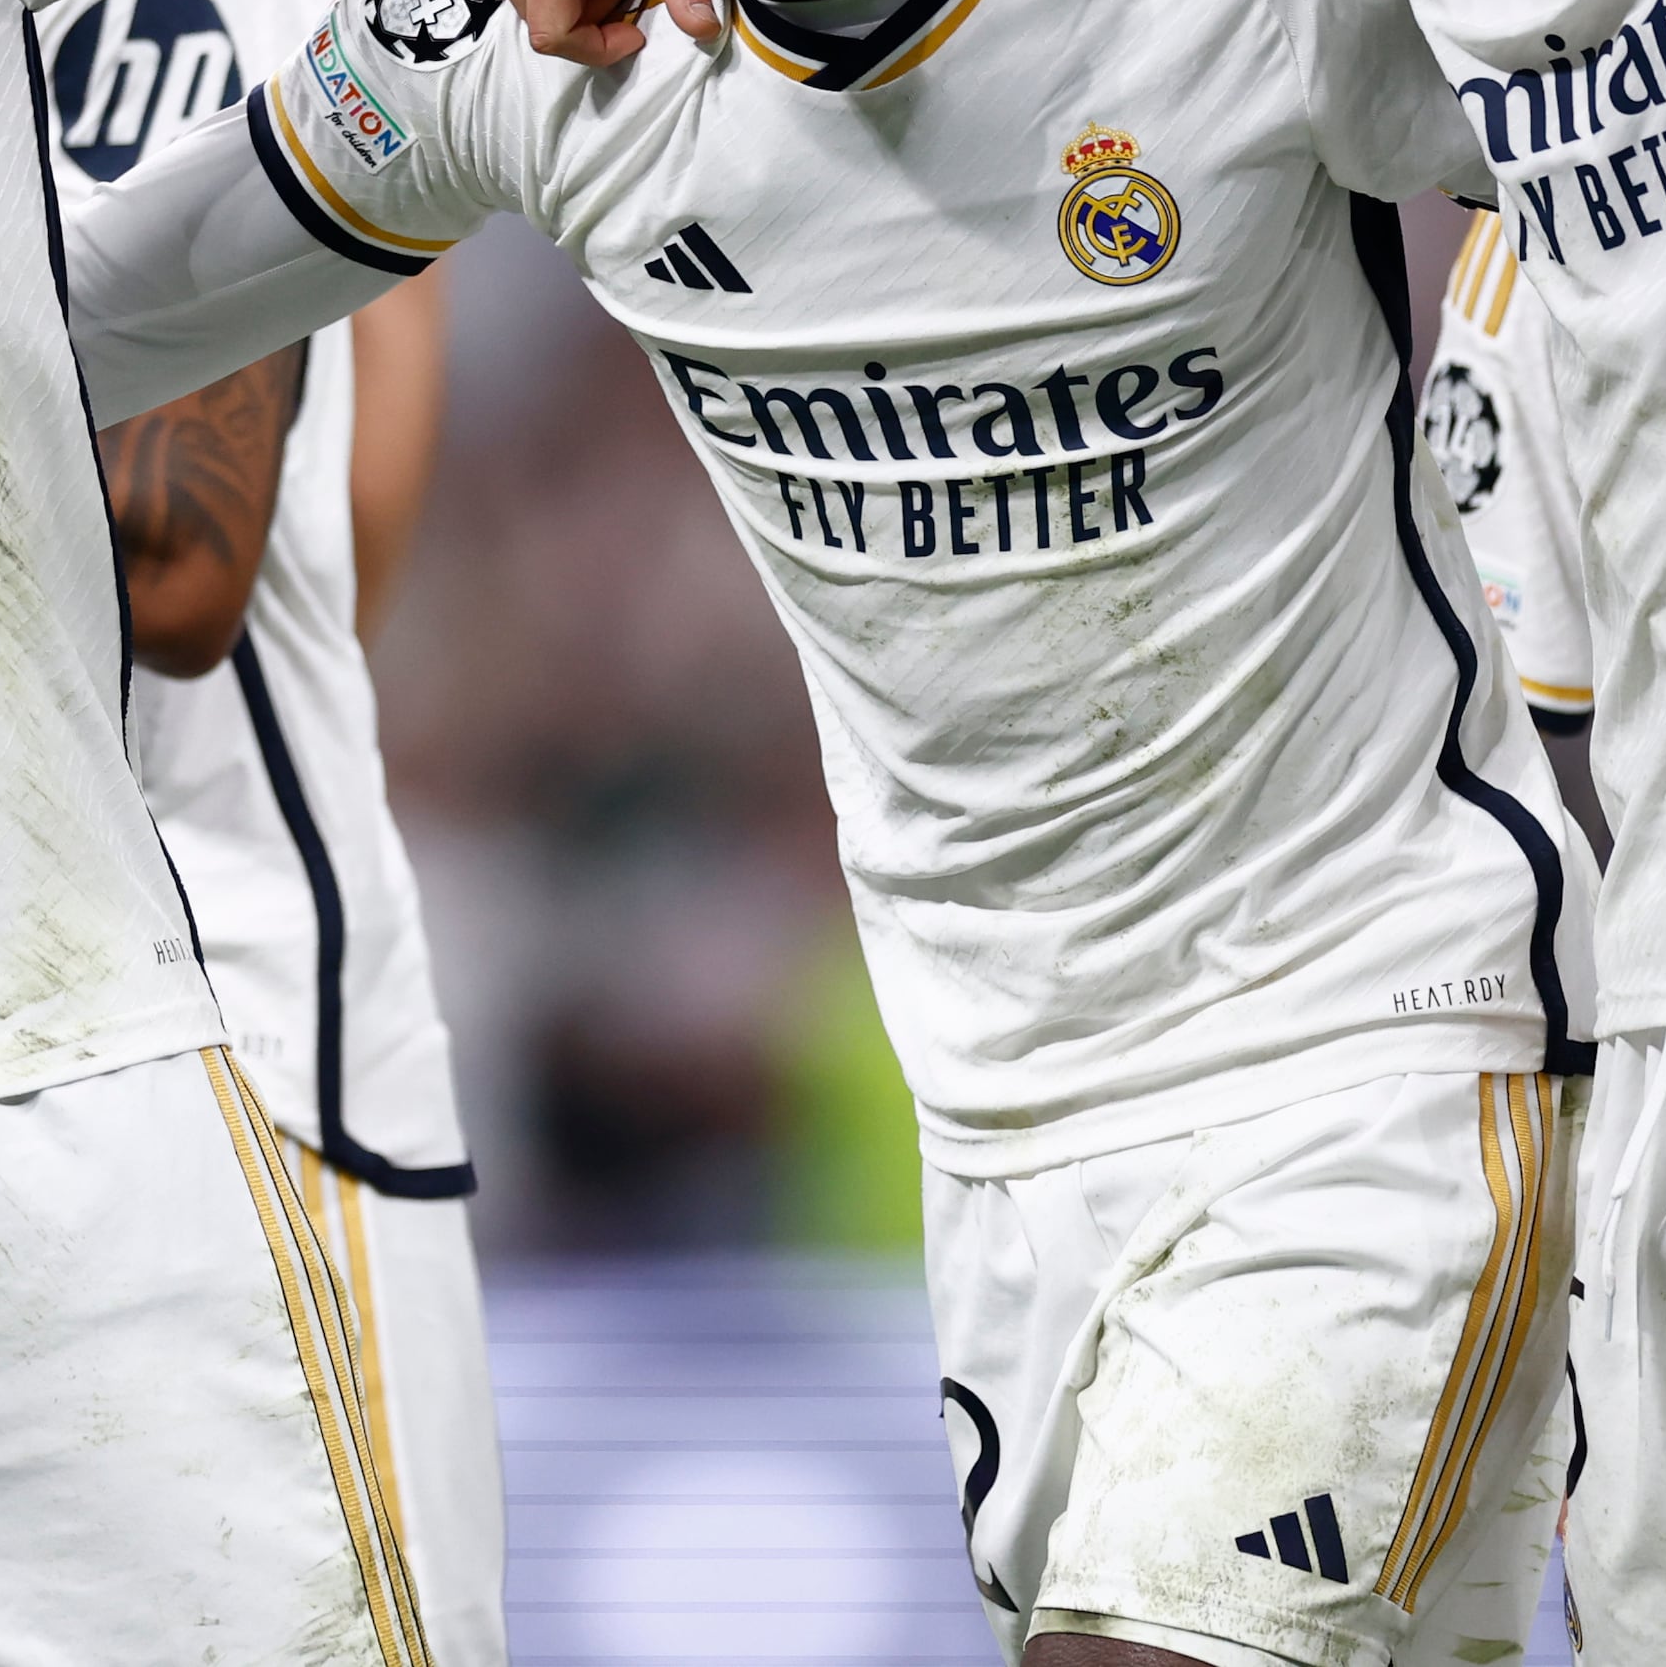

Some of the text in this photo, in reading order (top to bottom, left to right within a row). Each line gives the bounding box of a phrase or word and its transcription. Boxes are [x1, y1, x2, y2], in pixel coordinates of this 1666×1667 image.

[660, 345, 1224, 462] Emirates
[777, 448, 1154, 558] FLY BETTER
[1392, 973, 1506, 1014] HEAT.RDY
